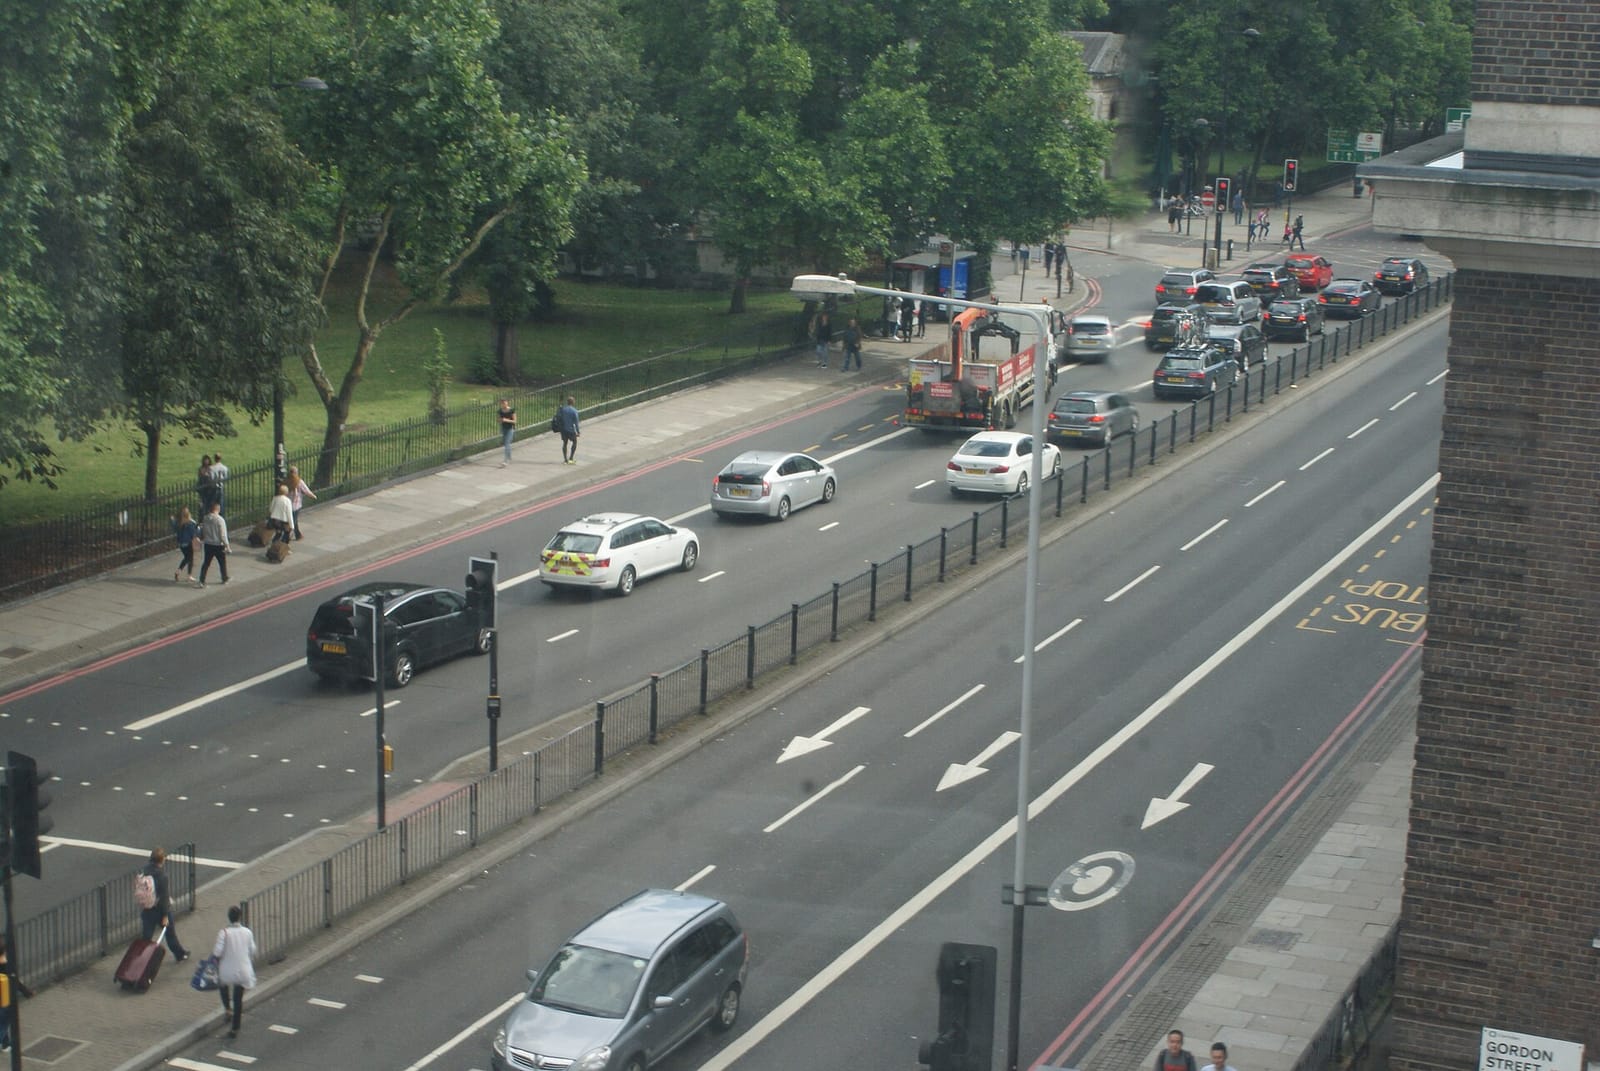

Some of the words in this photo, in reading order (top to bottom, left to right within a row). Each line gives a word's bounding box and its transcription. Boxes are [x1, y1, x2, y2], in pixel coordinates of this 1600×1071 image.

[1346, 580, 1427, 605] TOP
[1331, 603, 1427, 633] BUS
[1486, 1041, 1554, 1062] GORDON
[1486, 1056, 1543, 1071] STREET
